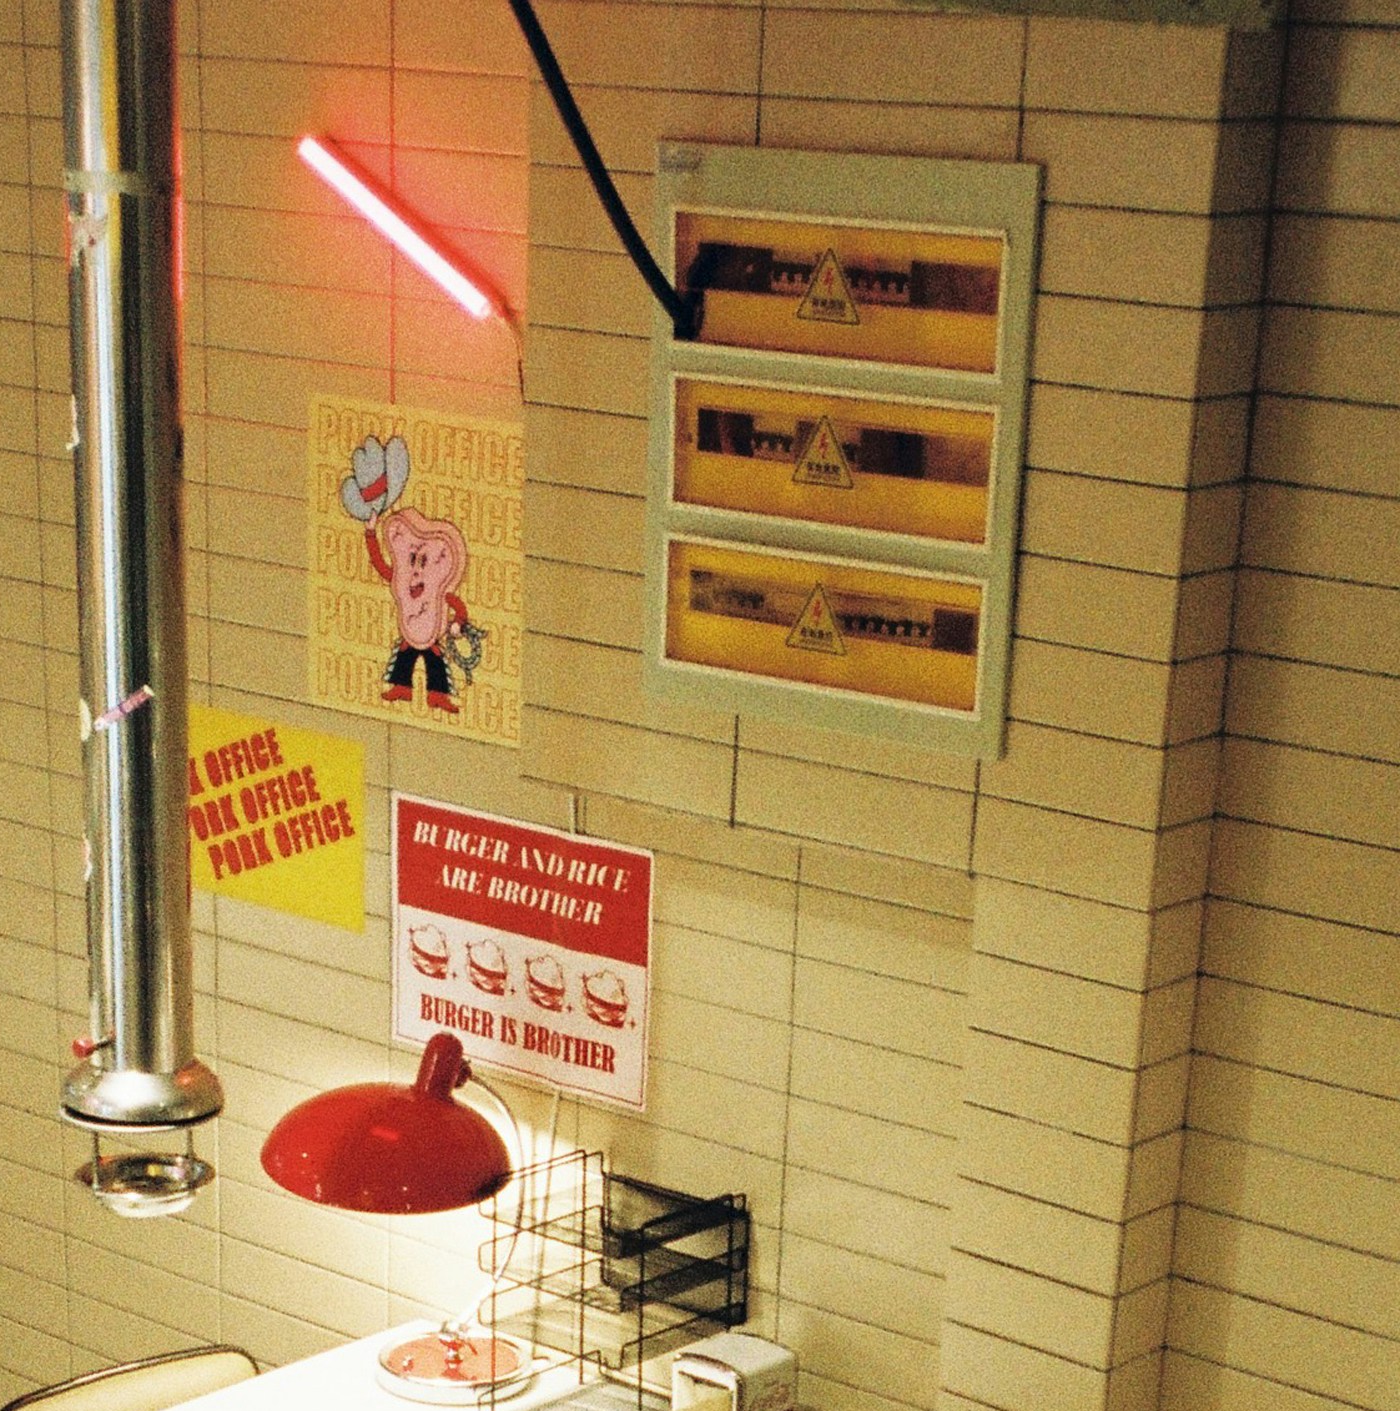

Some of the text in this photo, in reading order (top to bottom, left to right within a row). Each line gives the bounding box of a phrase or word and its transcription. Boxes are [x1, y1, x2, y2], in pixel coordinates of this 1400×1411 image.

[413, 419, 524, 490] OFFICE
[204, 727, 285, 788] OFFICE
[187, 794, 240, 832] ORK
[239, 764, 322, 825] OFFICE
[207, 798, 356, 881] PORK OFFICE
[413, 820, 632, 893] BURGER AND RICE
[435, 864, 603, 926] ARE BROTHER
[420, 993, 616, 1075] BURGER IS BROTHER
